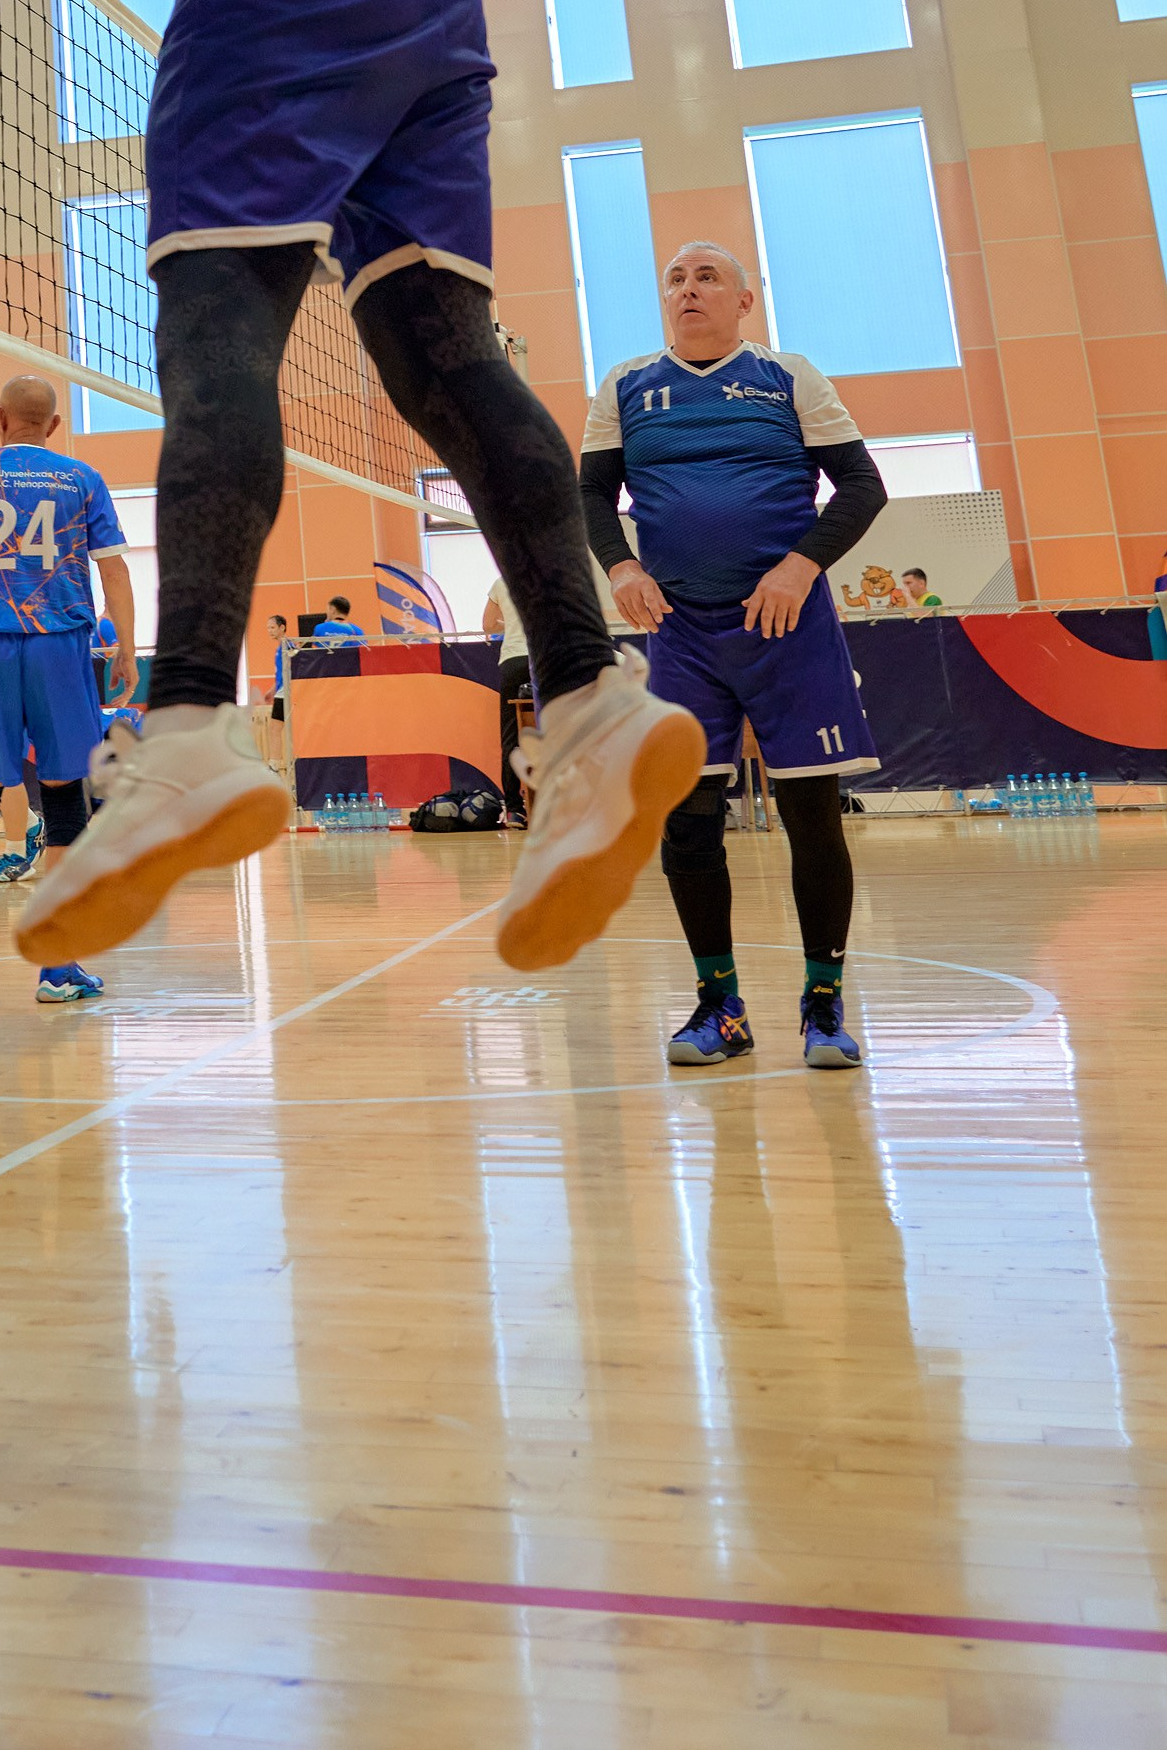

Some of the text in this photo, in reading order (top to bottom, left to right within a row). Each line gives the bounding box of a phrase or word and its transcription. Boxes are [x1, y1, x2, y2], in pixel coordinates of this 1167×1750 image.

[641, 385, 671, 411] 11
[54, 470, 74, 482] ГЭС
[13, 479, 79, 494] Непорожнего
[815, 724, 845, 755] 11
